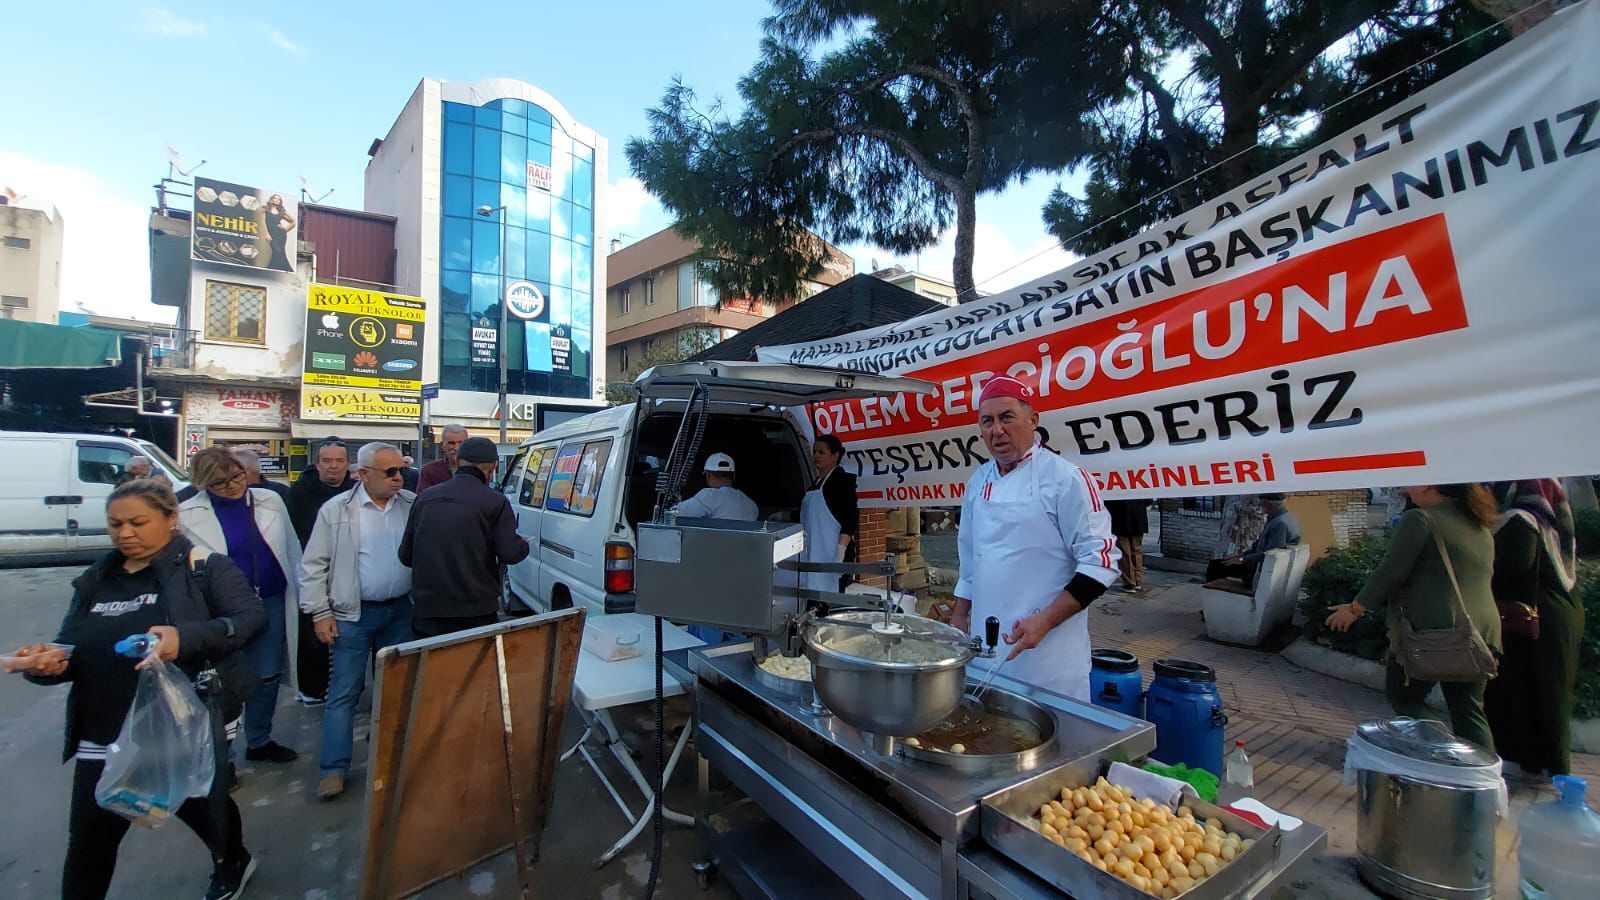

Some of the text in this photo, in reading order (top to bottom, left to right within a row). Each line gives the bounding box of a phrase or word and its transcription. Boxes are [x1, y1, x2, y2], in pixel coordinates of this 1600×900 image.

[933, 279, 1068, 331] YAPILAN
[1073, 221, 1194, 286] SICAK
[1210, 103, 1426, 228] ASFALT
[934, 306, 1045, 356] DOLAYI
[1053, 256, 1176, 322] SAYIN
[1185, 99, 1600, 279] BAŞKANIMIZ
[315, 293, 376, 306] ROYAL
[317, 328, 344, 339] iPhone
[474, 329, 495, 340] AVUKAT
[216, 388, 278, 404] YAMAN
[310, 393, 371, 407] ROYAL
[815, 391, 911, 435] ÖZLEM
[847, 369, 1363, 483] TEŞEKKR EDERİZ
[886, 483, 945, 501] KONAK
[1091, 453, 1275, 491] SAKİNLERİ
